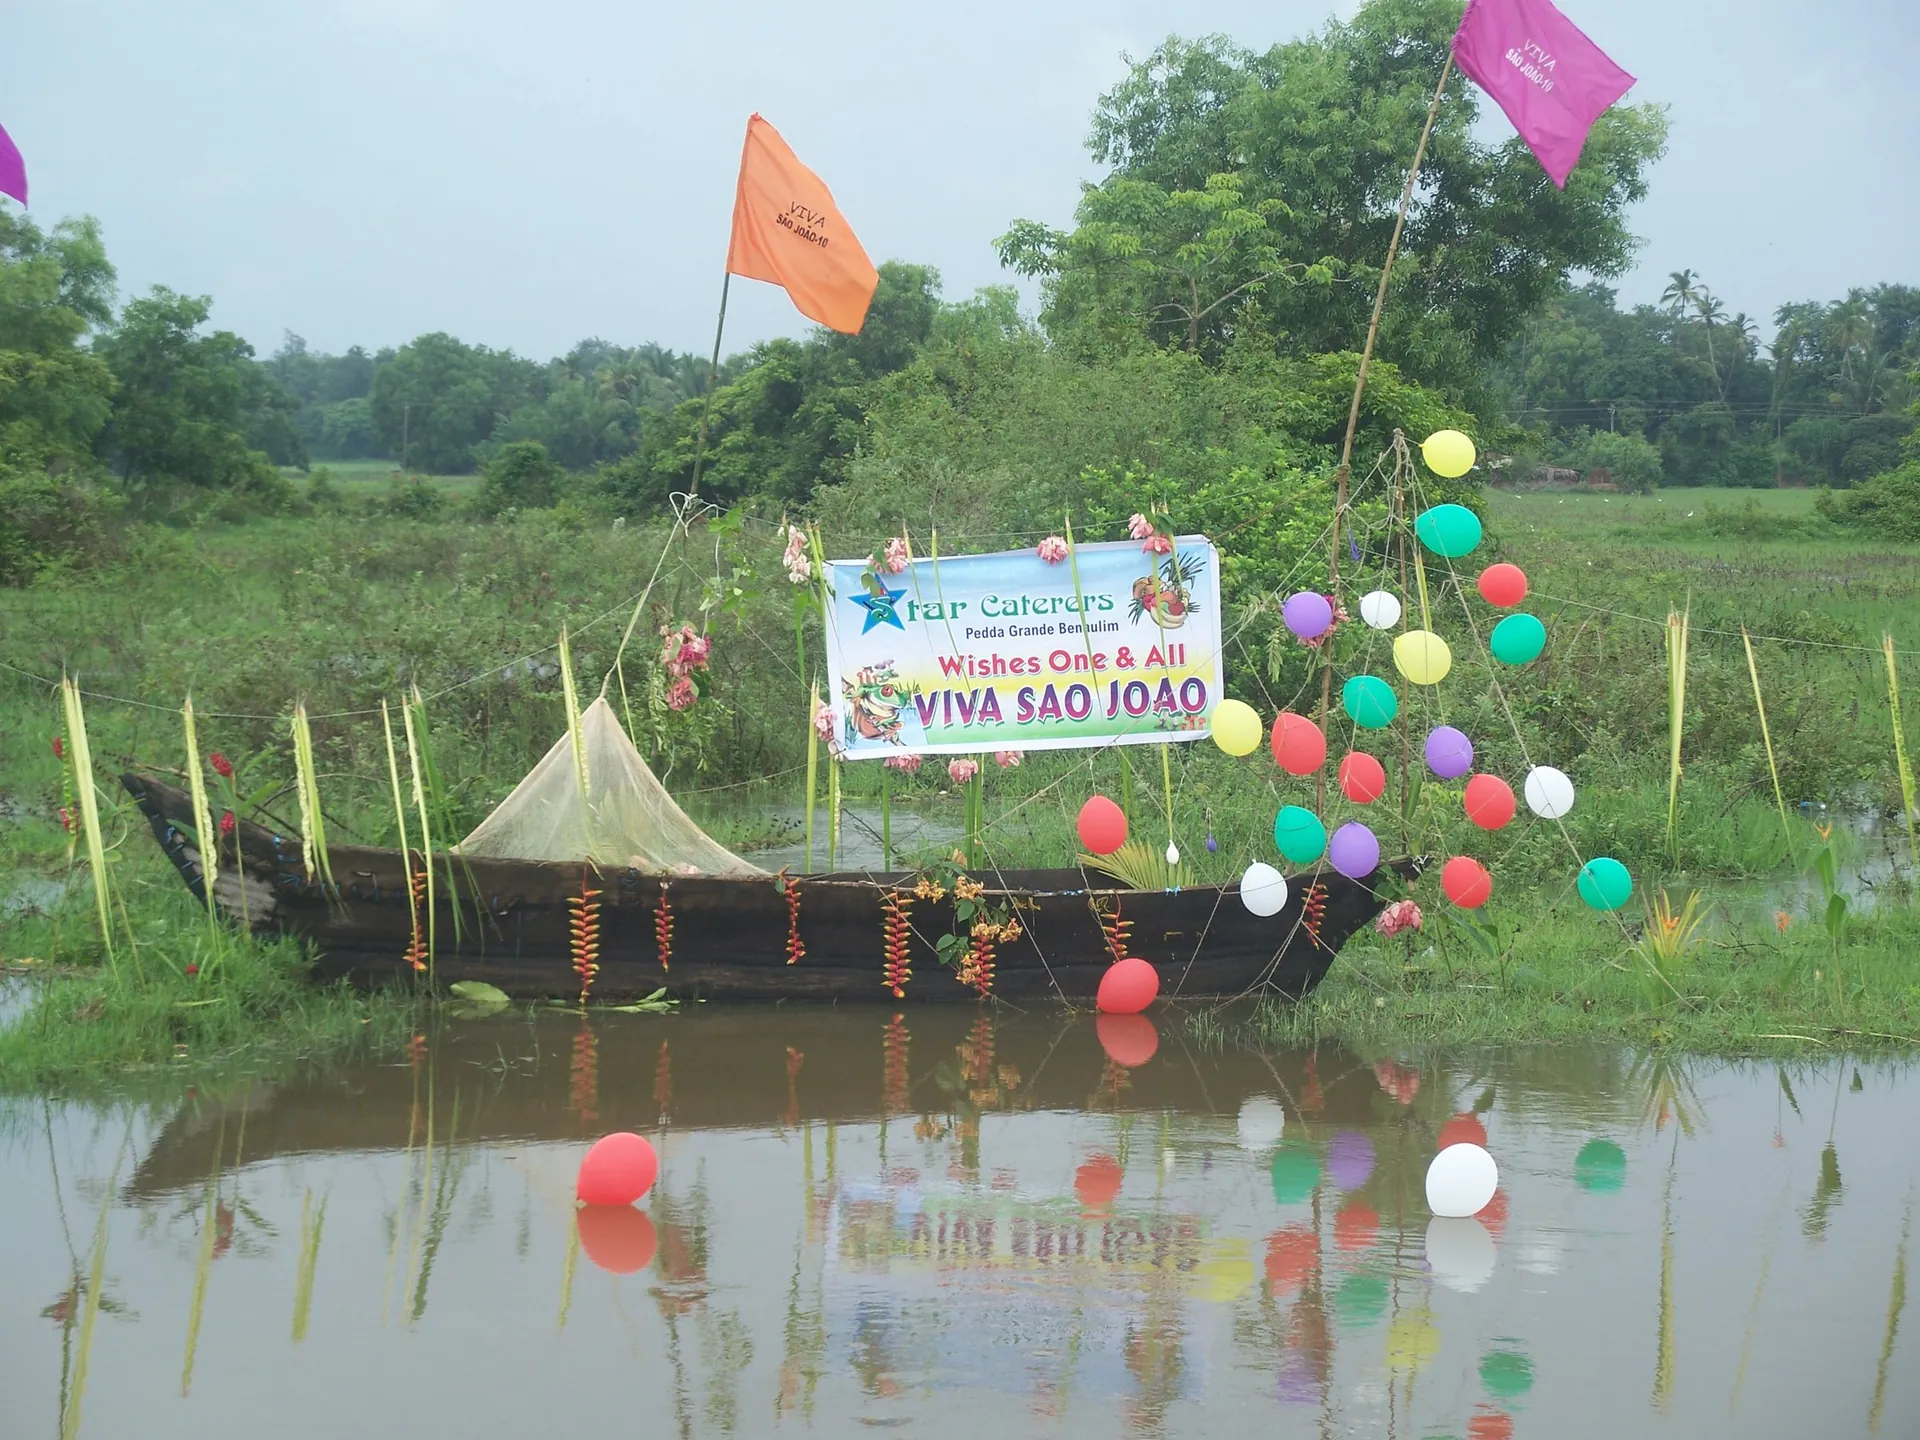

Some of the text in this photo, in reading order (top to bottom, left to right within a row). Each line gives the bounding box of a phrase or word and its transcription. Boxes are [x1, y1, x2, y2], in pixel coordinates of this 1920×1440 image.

[1524, 39, 1556, 72] VIVA
[790, 201, 826, 228] VIVA
[981, 594, 1114, 617] Caterers
[966, 626, 1005, 639] Pedda
[1009, 623, 1055, 637] Grande
[938, 643, 1186, 678] Wishes One & All
[914, 676, 1208, 729] VIVA SAO JOAO
